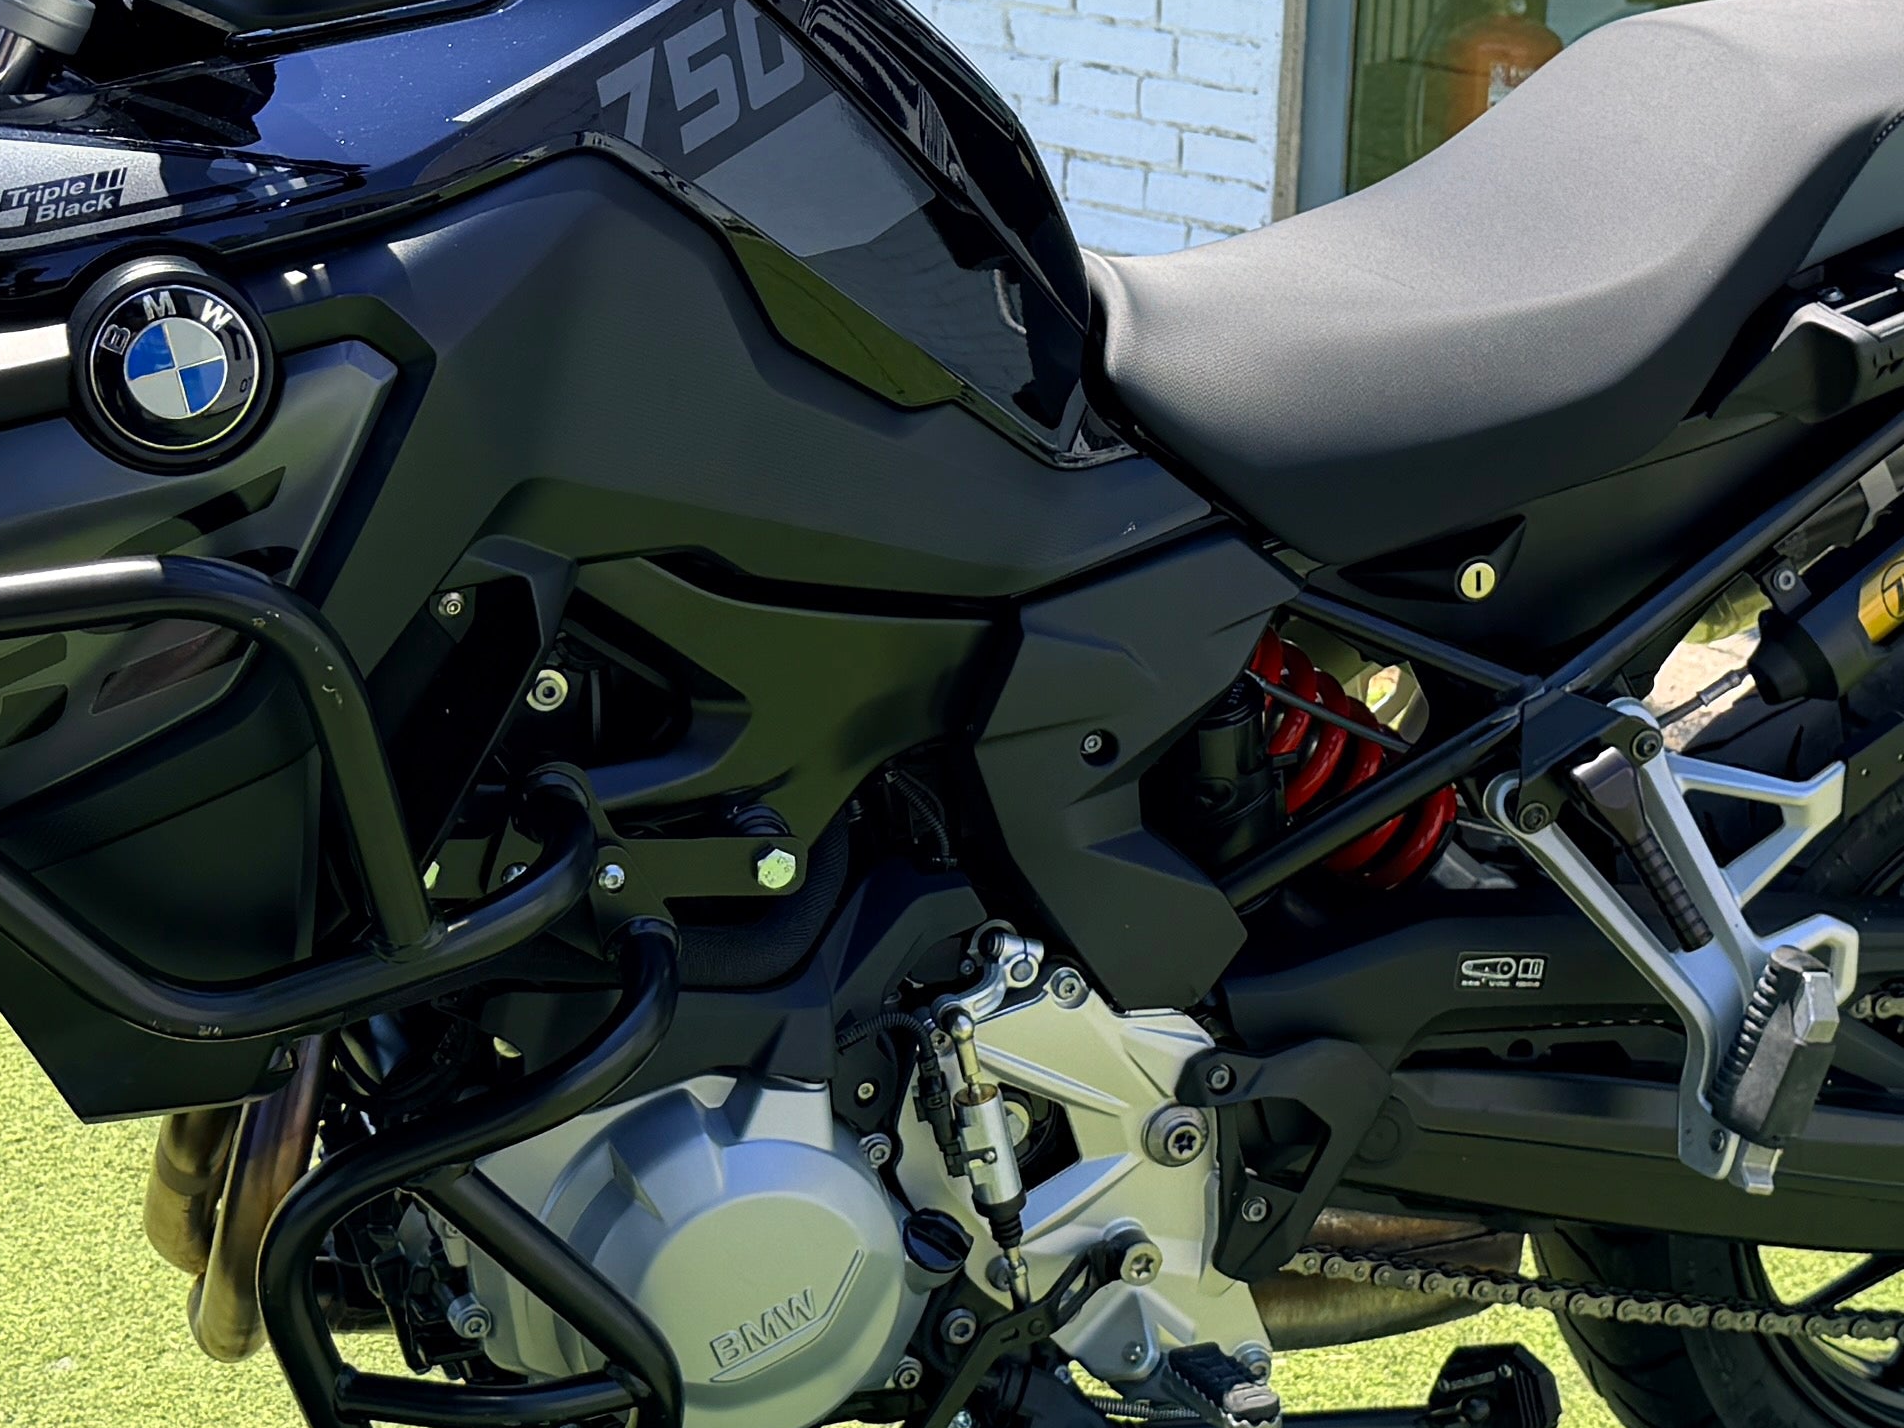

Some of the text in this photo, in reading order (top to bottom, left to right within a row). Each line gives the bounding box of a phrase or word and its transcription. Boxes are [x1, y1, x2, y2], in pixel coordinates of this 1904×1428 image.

[7, 178, 88, 207] Triple
[35, 194, 114, 224] Black
[100, 288, 234, 356] BMW
[710, 1289, 817, 1369] BMW
